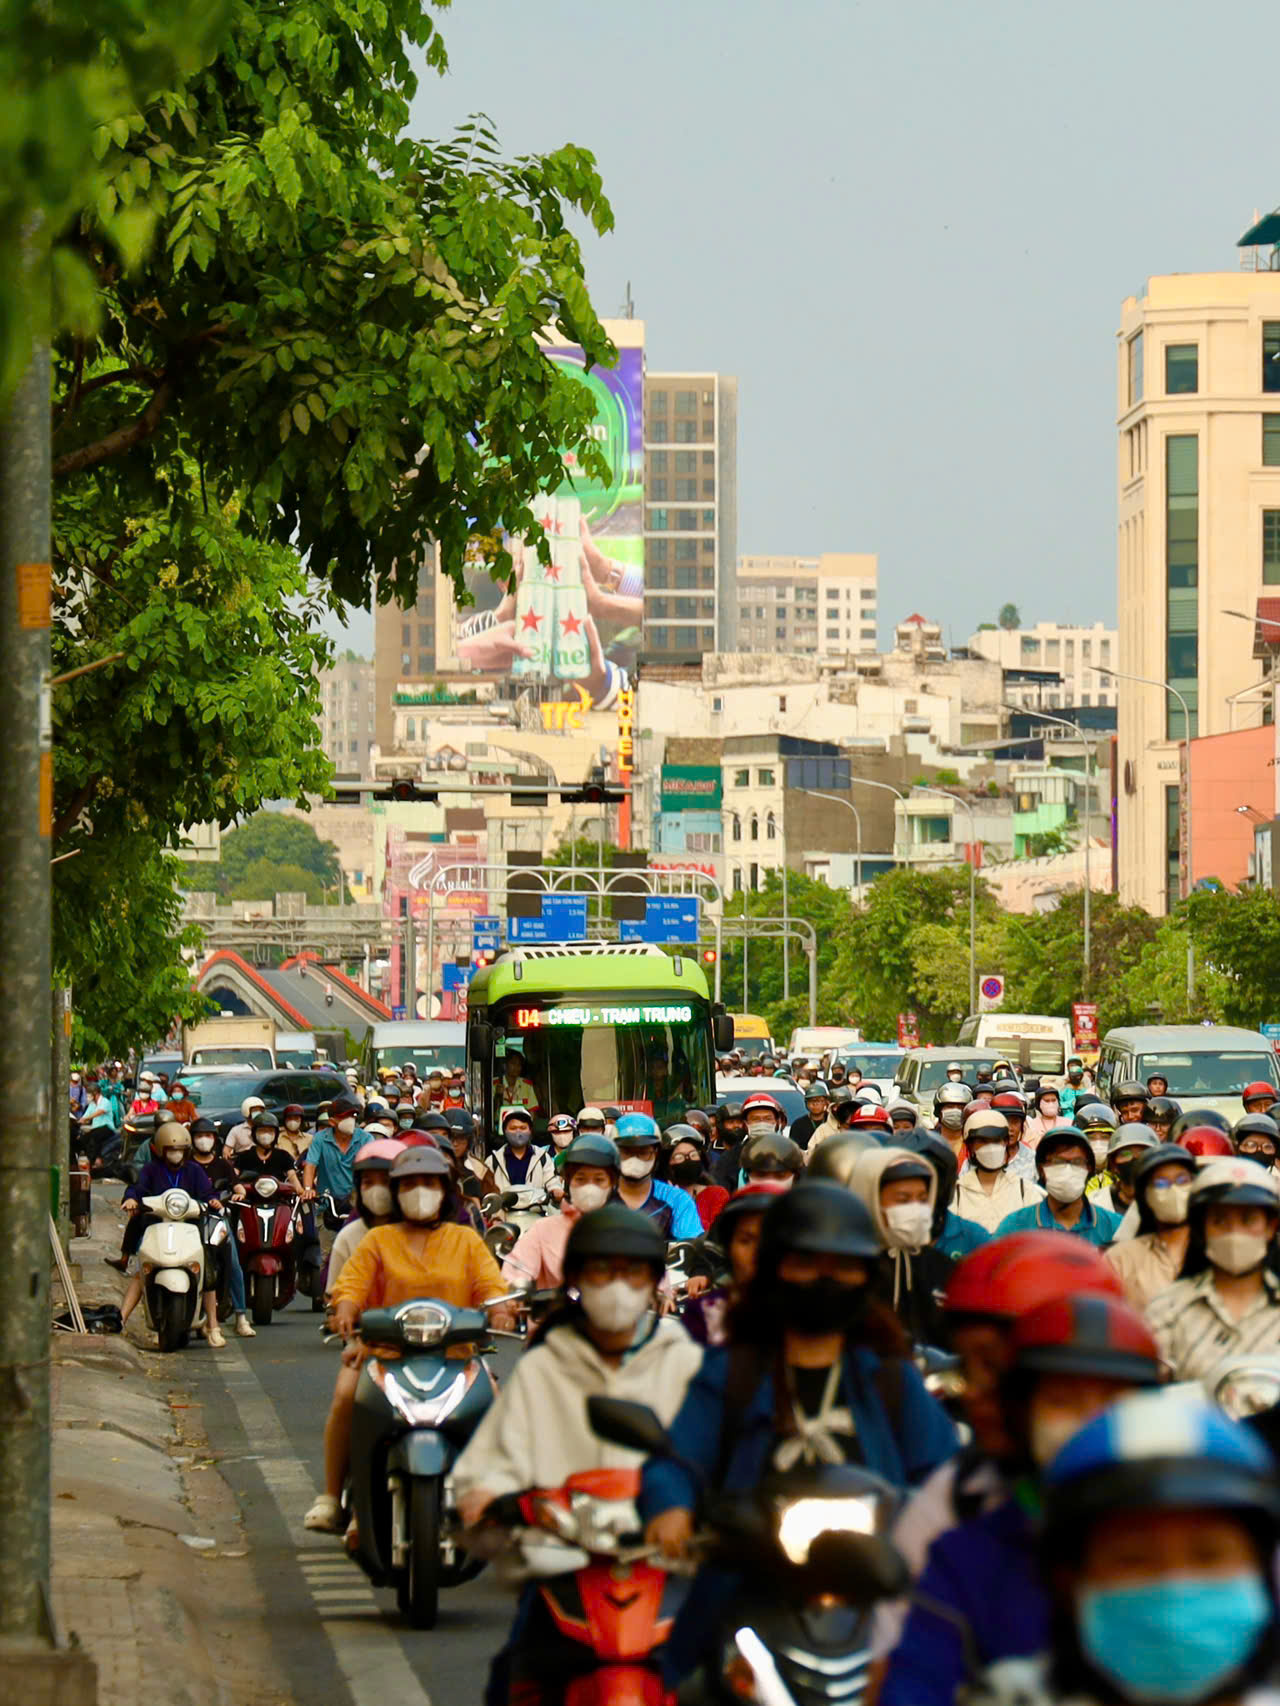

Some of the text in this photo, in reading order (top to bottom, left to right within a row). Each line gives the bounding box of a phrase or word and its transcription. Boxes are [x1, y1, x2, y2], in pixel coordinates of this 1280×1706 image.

[540, 702, 583, 729] TTC
[617, 688, 634, 771] HOTEL
[642, 1006, 692, 1023] TRUNG
